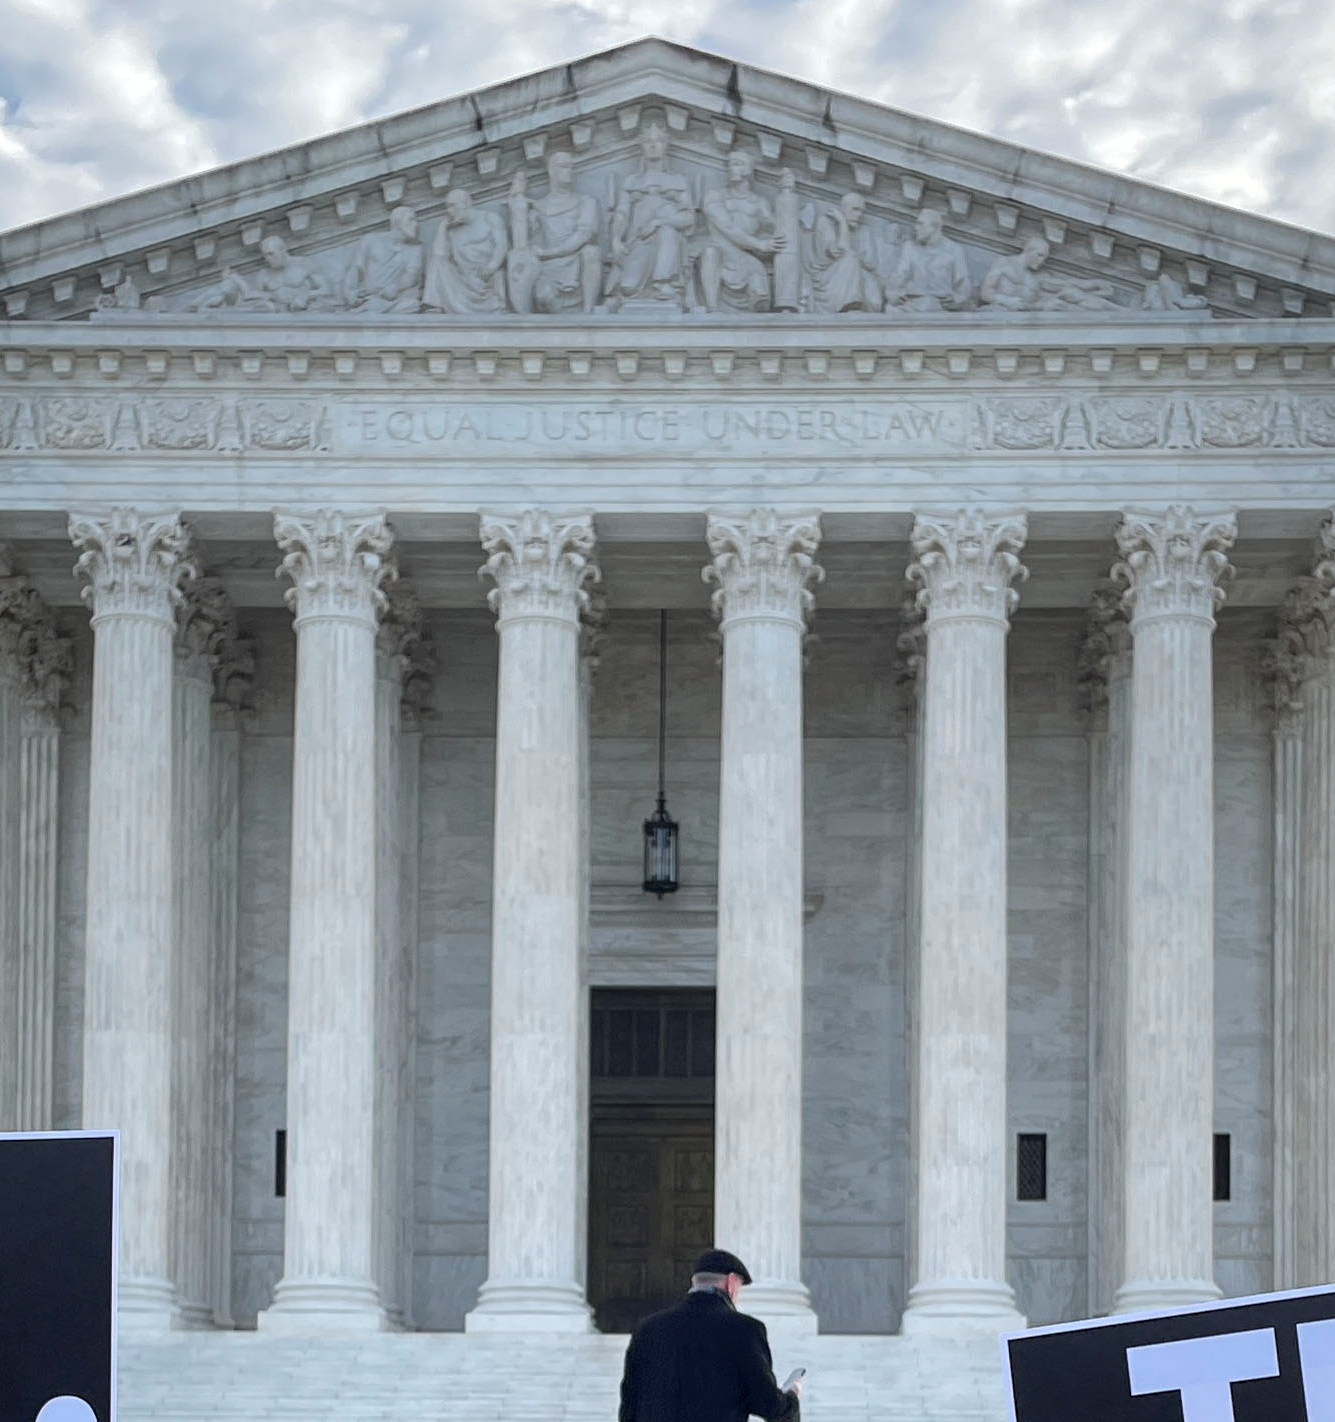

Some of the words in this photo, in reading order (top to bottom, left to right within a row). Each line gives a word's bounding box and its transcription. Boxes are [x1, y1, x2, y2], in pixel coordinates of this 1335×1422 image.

[360, 410, 503, 443] EQUAL
[514, 410, 679, 441] JUSTICE
[702, 410, 845, 442] UNDER
[861, 410, 945, 441] LAW
